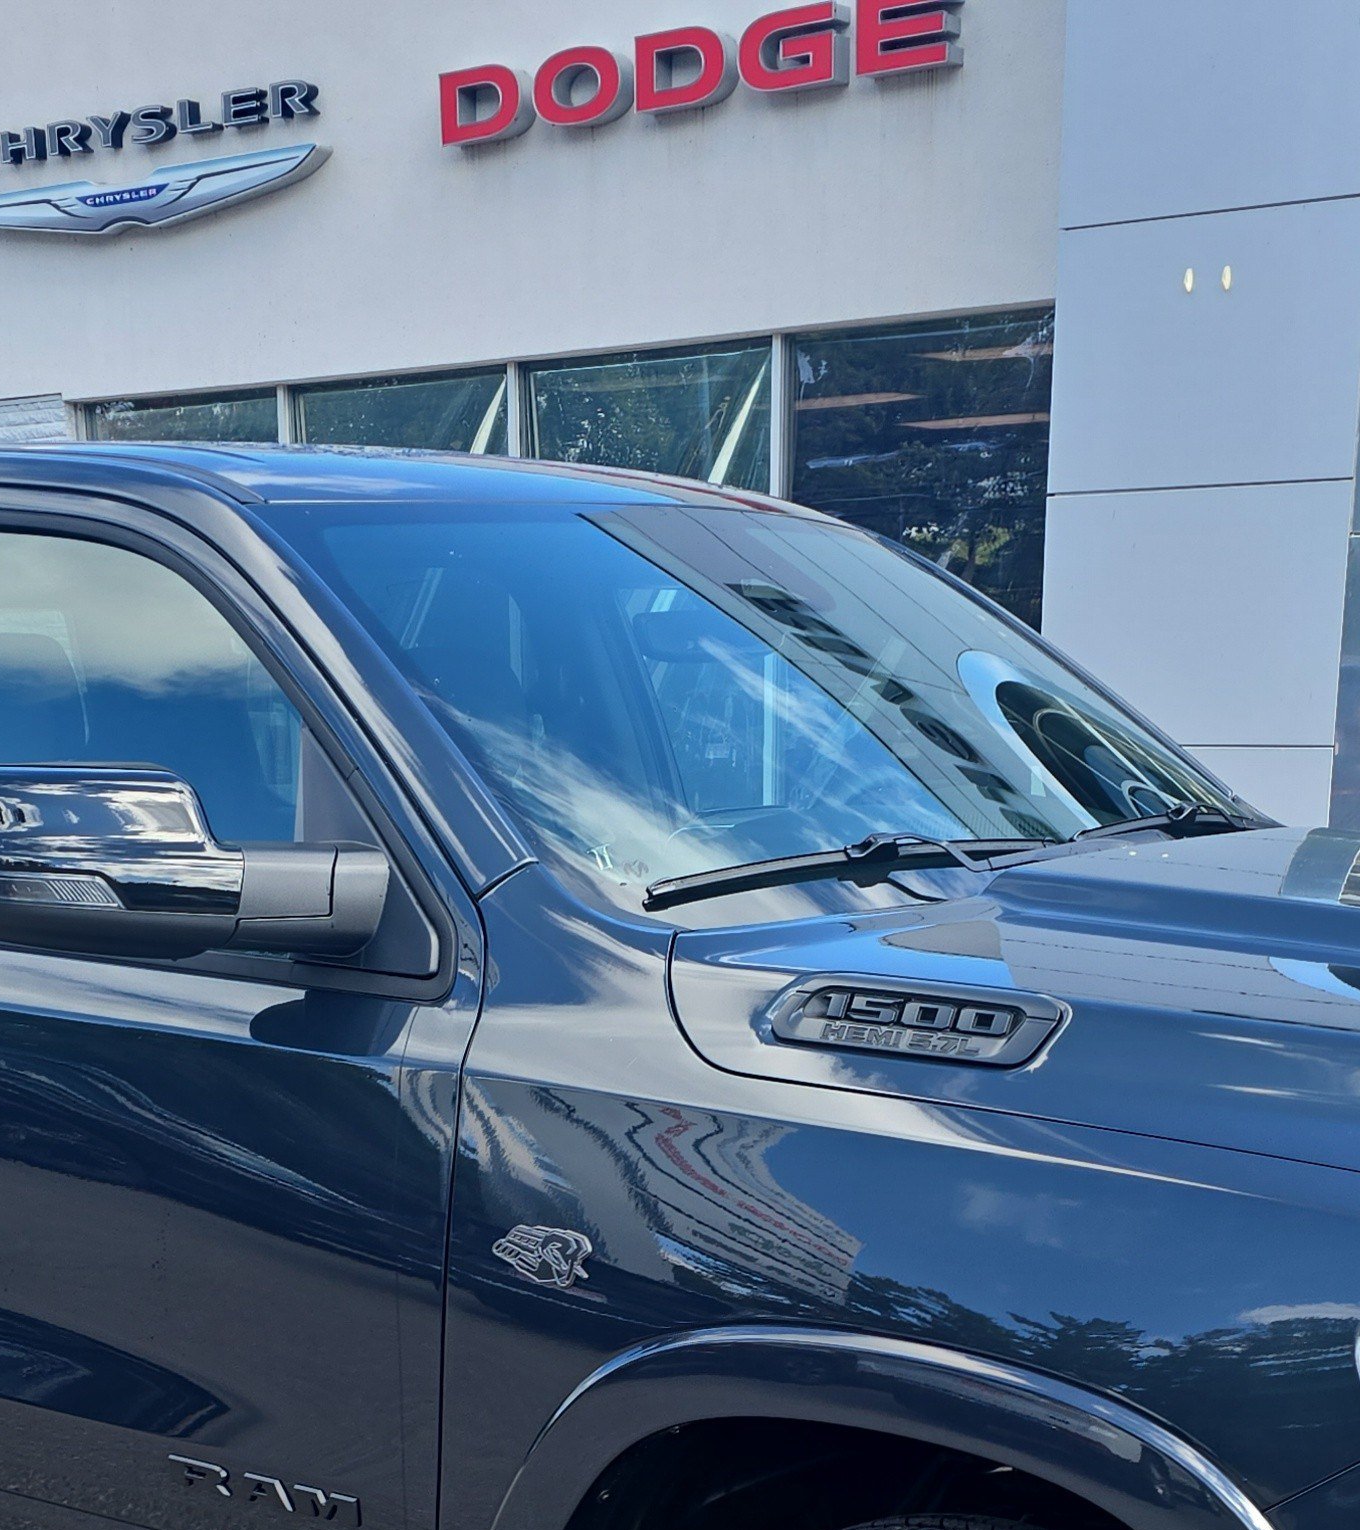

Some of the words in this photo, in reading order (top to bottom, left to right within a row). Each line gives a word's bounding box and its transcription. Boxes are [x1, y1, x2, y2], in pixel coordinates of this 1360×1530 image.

[439, 0, 964, 147] DODGE
[85, 187, 159, 205] CHRYSLER
[824, 990, 1014, 1038] 1500
[819, 1021, 905, 1049] HEMI
[907, 1031, 982, 1057] 5.7L
[167, 1453, 363, 1528] RAM
